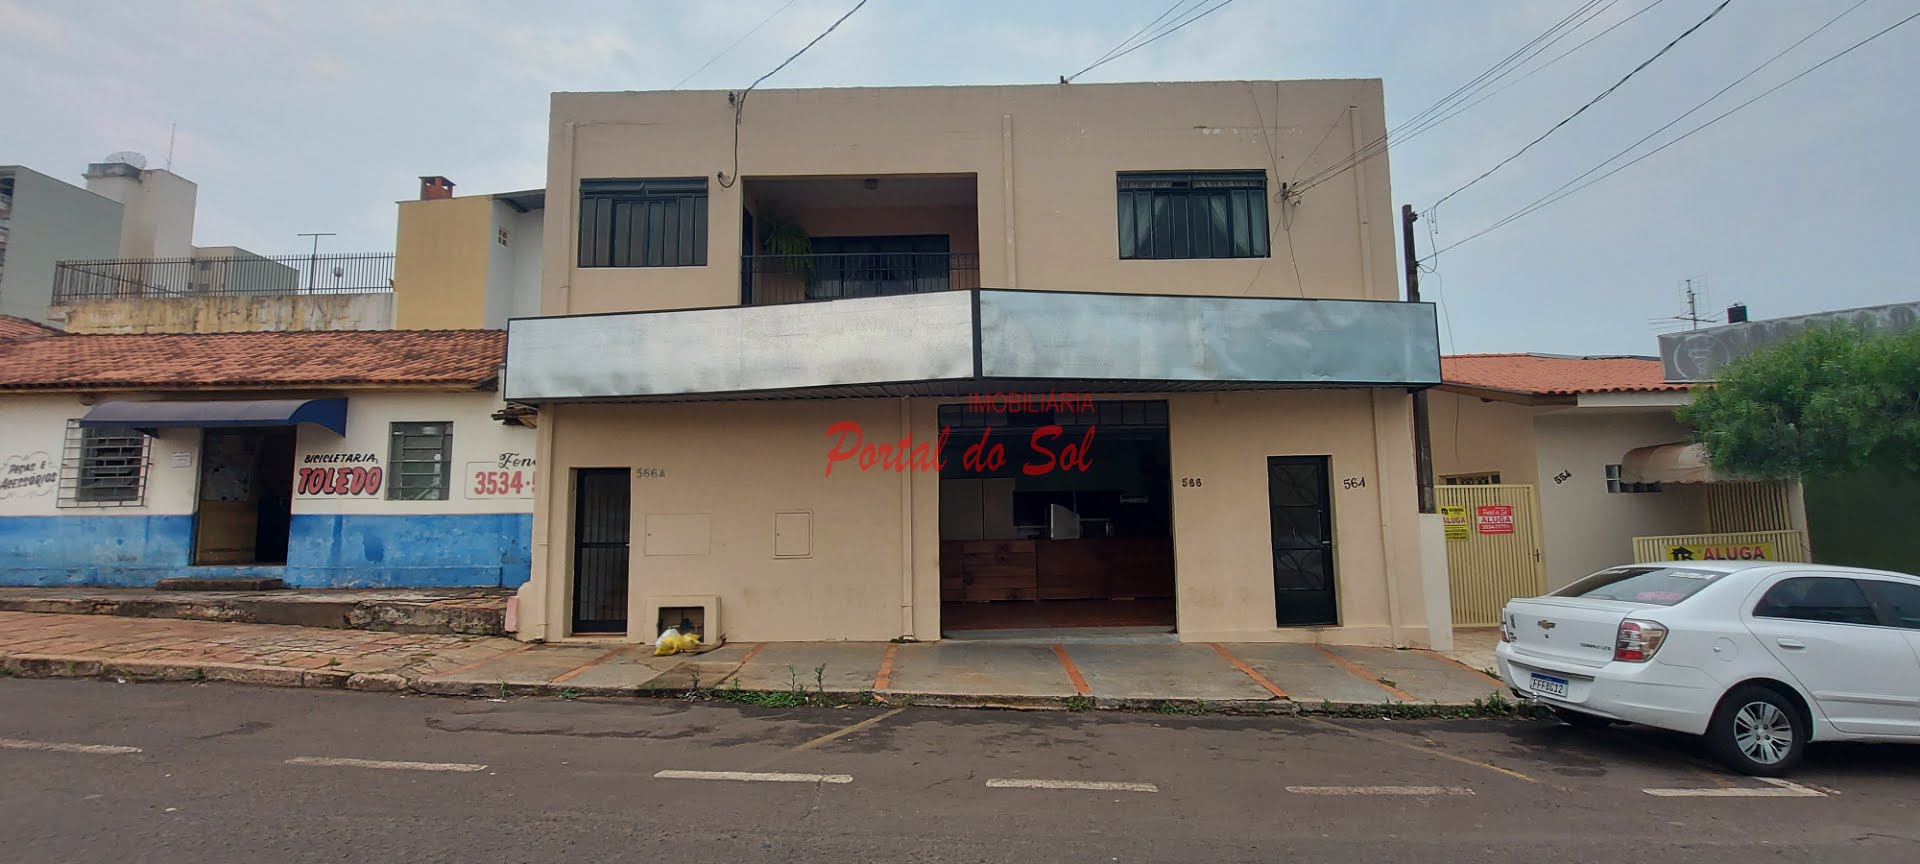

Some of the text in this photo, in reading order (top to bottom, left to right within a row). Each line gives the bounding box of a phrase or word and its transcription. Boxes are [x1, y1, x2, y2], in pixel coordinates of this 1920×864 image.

[40, 460, 46, 470] E
[298, 466, 383, 495] TOLEDO
[1181, 477, 1203, 488] 566
[1343, 477, 1367, 490] 564
[1553, 469, 1572, 485] 554
[1443, 516, 1466, 524] ALUGA
[1703, 545, 1766, 561] ALUGA
